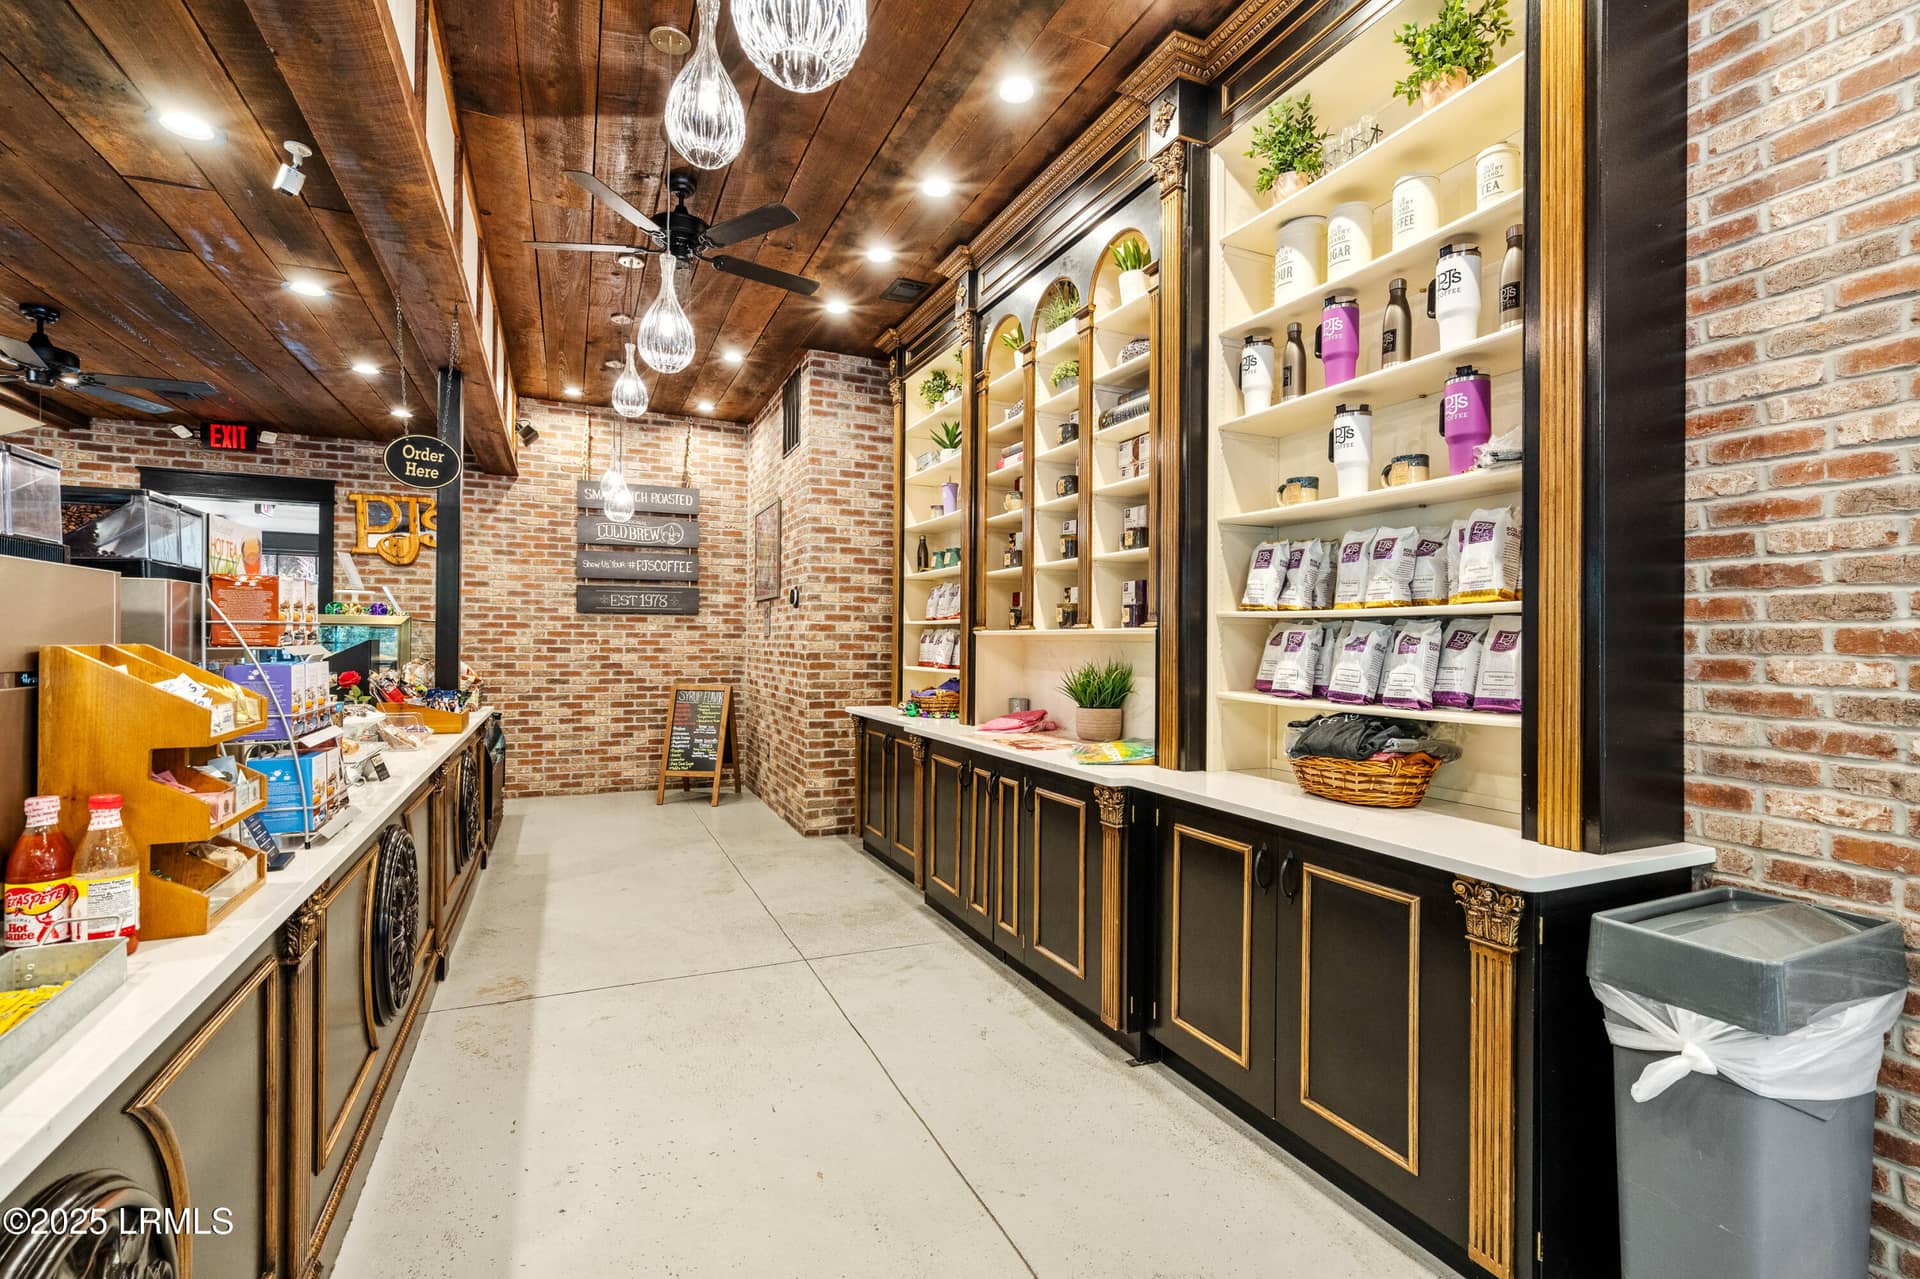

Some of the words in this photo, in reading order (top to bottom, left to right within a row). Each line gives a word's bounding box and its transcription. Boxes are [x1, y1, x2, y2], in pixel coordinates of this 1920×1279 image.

[210, 424, 249, 449] EXIT
[402, 444, 445, 463] Order
[405, 461, 439, 479] Here
[650, 492, 693, 506] ROASTED
[597, 524, 628, 539] COLD
[628, 526, 660, 541] BREW
[639, 593, 668, 608] 1978
[8, 922, 28, 933] Hot
